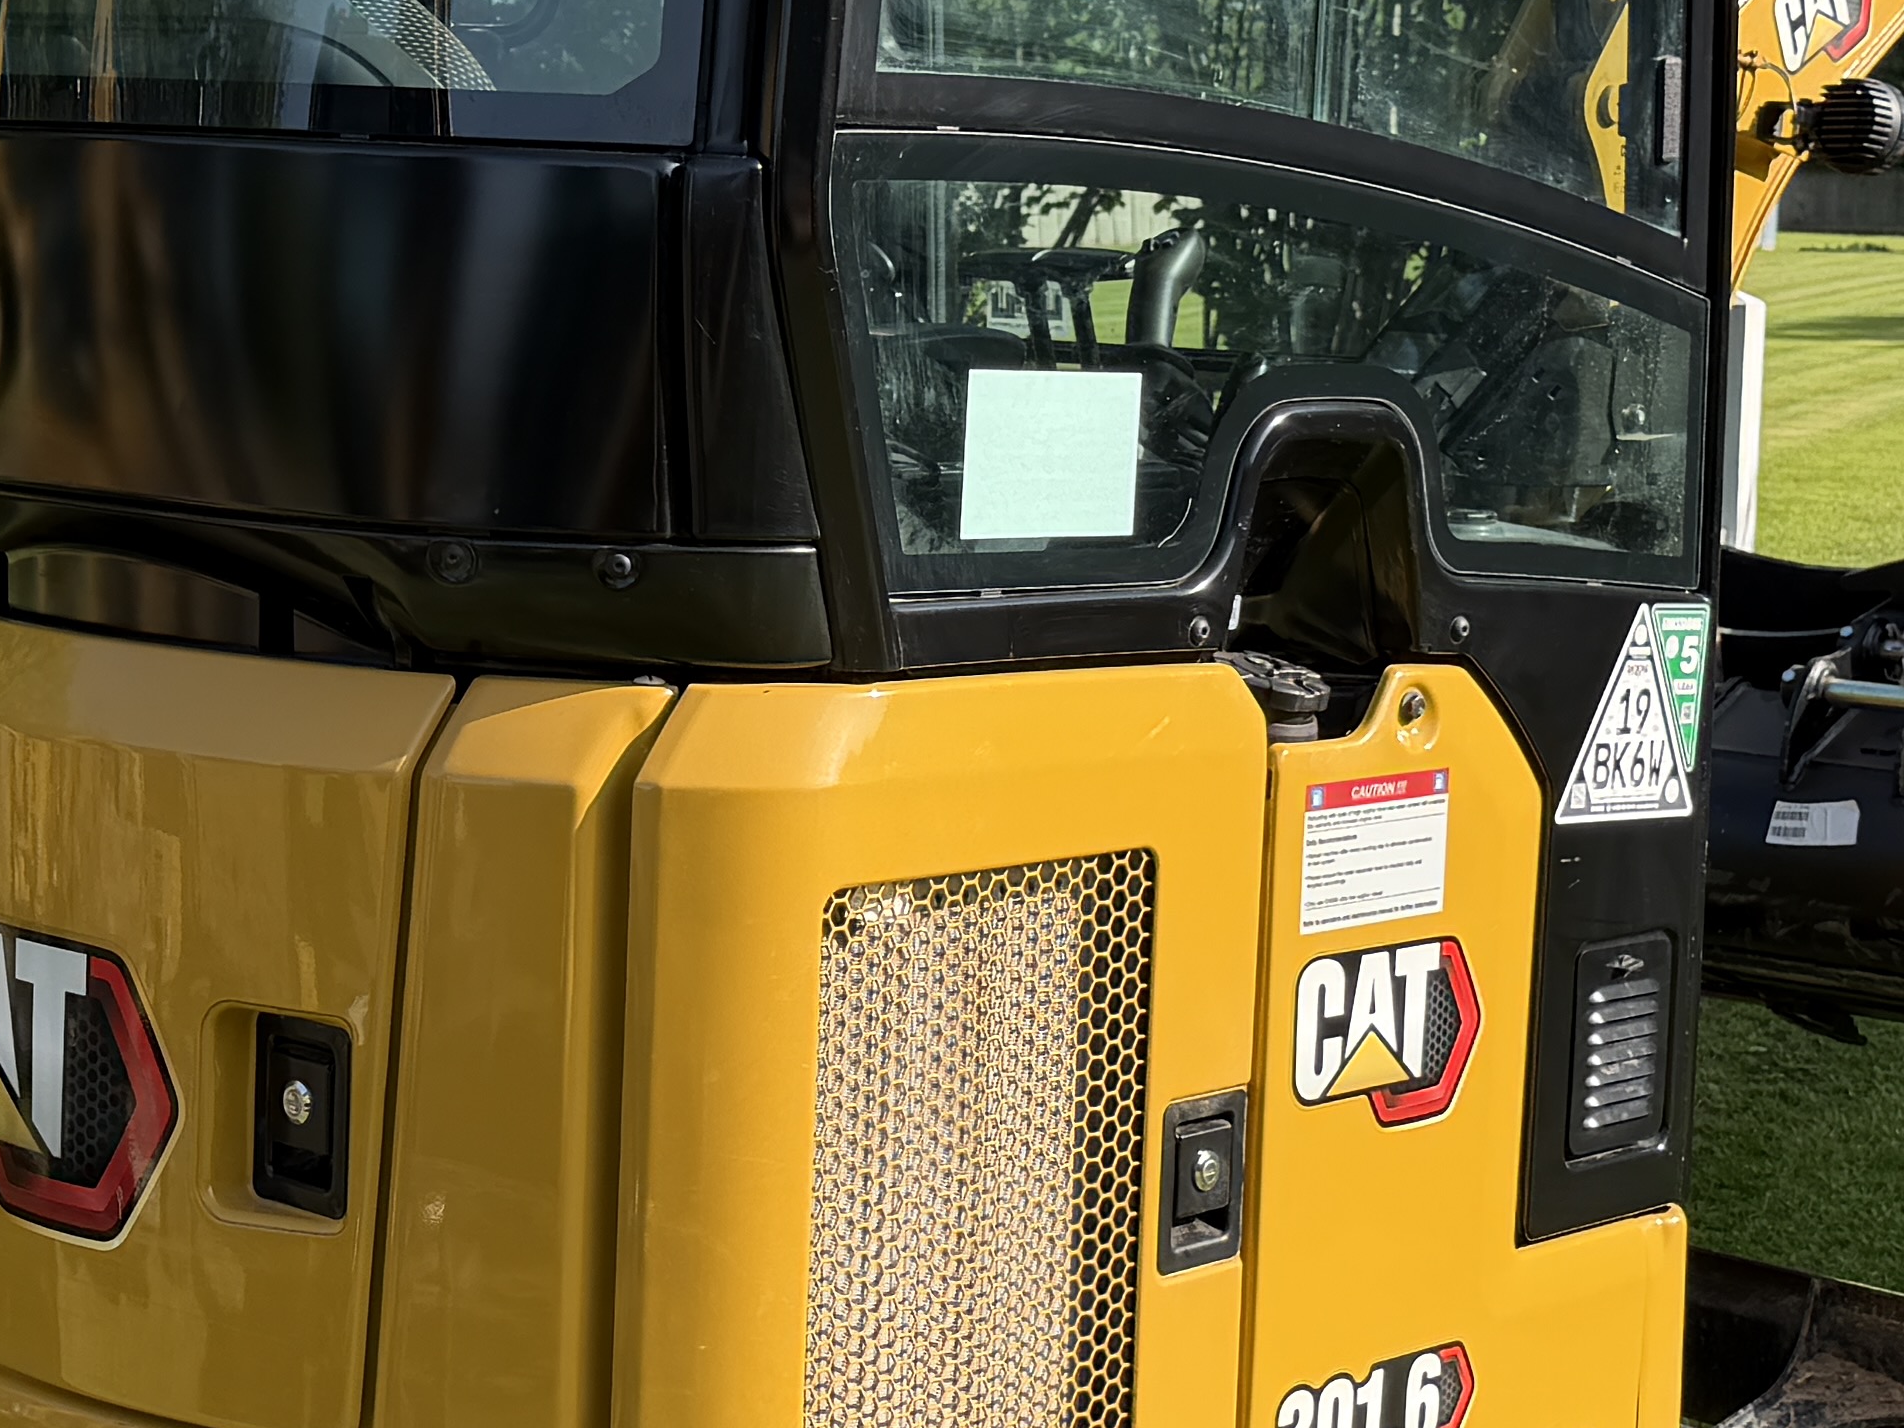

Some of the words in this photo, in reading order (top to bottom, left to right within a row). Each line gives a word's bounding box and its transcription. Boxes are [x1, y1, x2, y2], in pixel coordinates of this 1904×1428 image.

[1679, 635, 1699, 674] 5
[1616, 688, 1651, 735] 19
[1592, 740, 1665, 790] BK6W
[1351, 782, 1396, 799] CAUTION
[1295, 941, 1442, 1101] CAT
